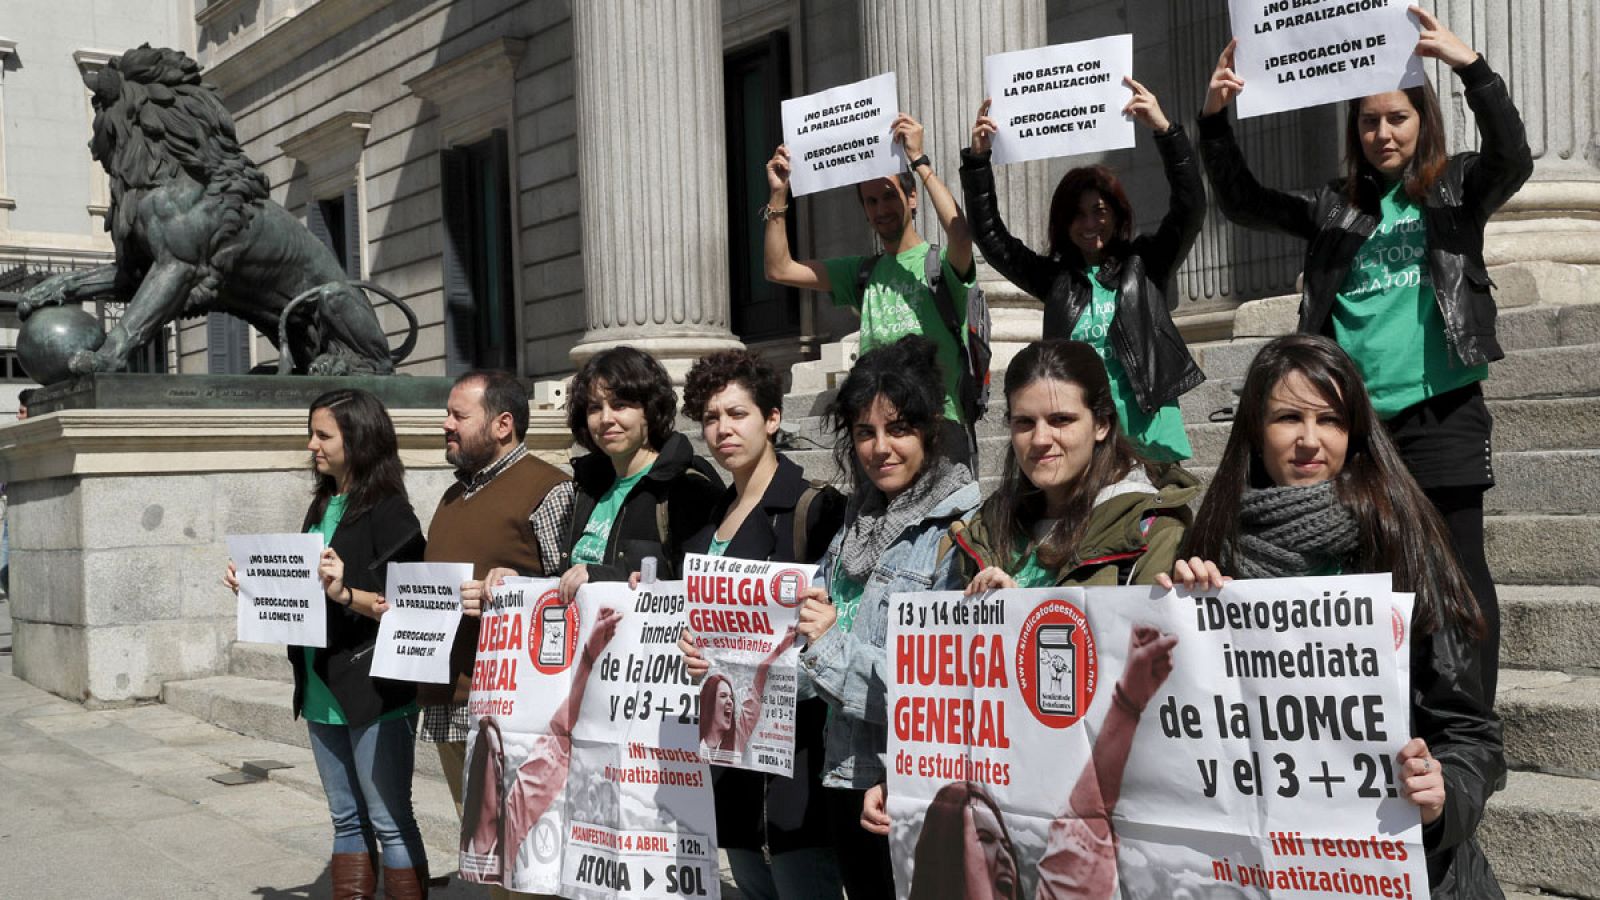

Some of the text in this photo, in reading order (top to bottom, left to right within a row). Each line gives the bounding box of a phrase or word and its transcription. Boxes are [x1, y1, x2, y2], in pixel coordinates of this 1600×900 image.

[1254, 22, 1272, 34] LA
[1264, 34, 1386, 71] ¡DEROGACIÓN DE
[1012, 60, 1101, 84] ¡NO BASTA CON
[1278, 55, 1376, 84] LA LOMCE YA!
[1004, 72, 1110, 97] LA PARALIZACIÓN!
[797, 108, 880, 136] LA PARALIZACIÓN!
[804, 97, 873, 122] ¡NO BASTA CON
[1010, 103, 1106, 127] ¡DEROGACIÓN DE
[1019, 118, 1097, 138] LA LOMCE YA!
[804, 135, 880, 162] ¡DEROGACIÓN DE
[813, 149, 875, 172] LA LOMCE YA!
[264, 556, 288, 564] BASTA
[289, 556, 304, 564] CON
[689, 558, 771, 575] 13 y 14 de abril
[247, 568, 310, 579] LA PARALIZACIÓN!
[254, 597, 309, 608] ¡DEROGACIÓN DE
[412, 585, 436, 595] BASTA
[438, 586, 452, 595] CON
[688, 576, 768, 607] HUELGA
[259, 612, 304, 622] LA LOMCE YA!
[396, 599, 459, 611] LA PARALIZACIÓN!
[898, 600, 1005, 628] 13 y 14 de abril
[1195, 590, 1373, 632] ¡Derogación
[689, 608, 774, 635] GENERAL
[436, 632, 446, 642] DE
[696, 636, 772, 653] de estudiantes
[396, 645, 406, 655] LA
[406, 647, 426, 656] LOMCE
[897, 634, 1008, 689] HUELGA
[1224, 642, 1379, 679] inmediata
[601, 652, 620, 682] de
[625, 654, 643, 682] la
[610, 695, 620, 722] y
[624, 691, 639, 721] el
[640, 690, 652, 720] 3
[655, 697, 674, 722] +
[1159, 695, 1387, 741] de la LOMCE
[894, 696, 1010, 749] GENERAL
[628, 742, 646, 759] ¡Ni
[649, 747, 699, 763] recortes
[896, 749, 1010, 786] de estudiantes
[1197, 752, 1398, 798] y el 3 + 2!
[618, 836, 632, 850] 14
[636, 836, 669, 852] ABRIL
[680, 838, 705, 855] 12h.
[1269, 832, 1408, 861] ¡Ni recortes
[576, 854, 707, 896] ATOCHA SOL
[1212, 858, 1412, 900] ni privatizaciones!
